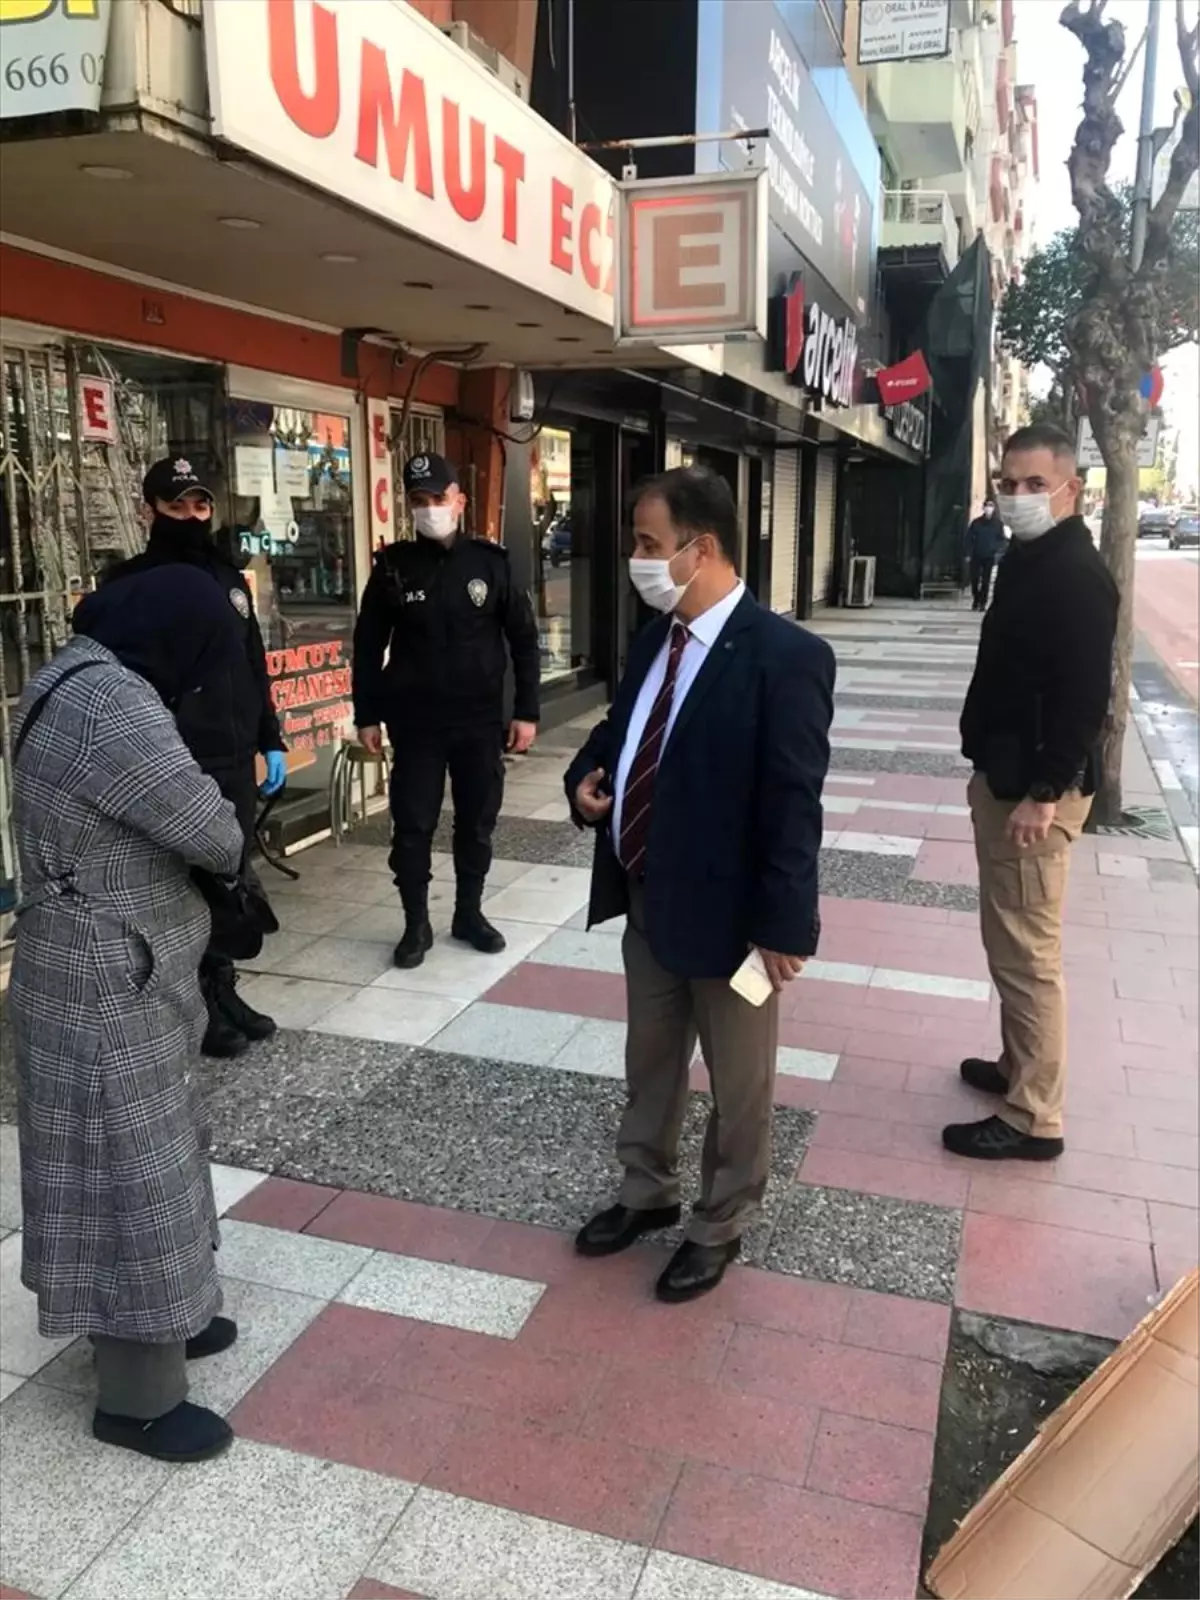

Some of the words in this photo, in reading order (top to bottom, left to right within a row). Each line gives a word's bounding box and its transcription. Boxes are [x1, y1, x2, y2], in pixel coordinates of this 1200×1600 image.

[5, 52, 69, 92] 666
[267, 0, 525, 246] UMUT
[652, 211, 726, 311] E
[83, 386, 109, 430] E
[265, 640, 343, 676] UMUT
[270, 658, 353, 712] CZANESİ
